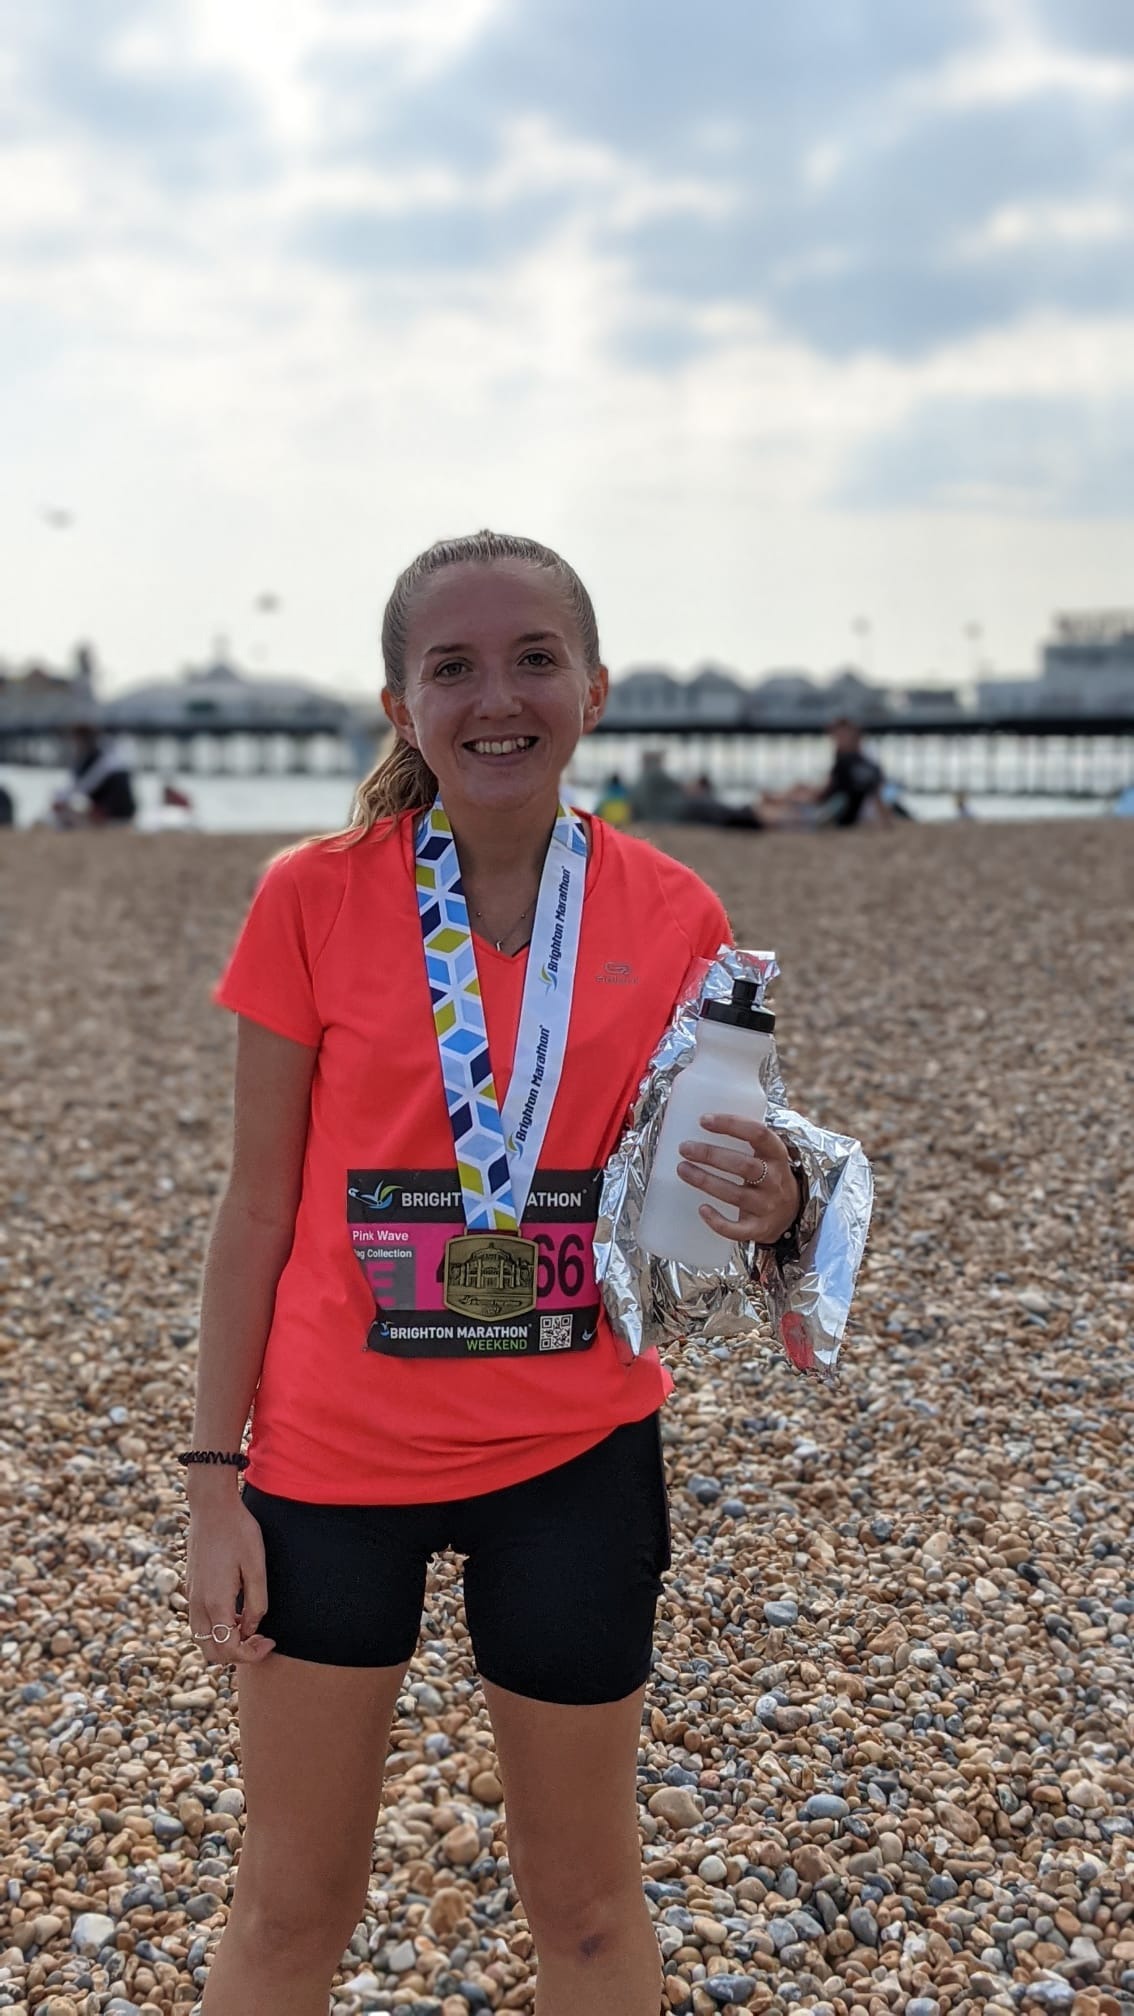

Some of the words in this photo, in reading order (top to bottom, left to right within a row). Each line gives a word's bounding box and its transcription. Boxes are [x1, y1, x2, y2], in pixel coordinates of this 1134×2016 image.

[555, 868, 571, 922] Marathon
[547, 922, 564, 973] Brighton
[515, 1088, 539, 1142] Brighton
[531, 1027, 550, 1087] Marathon
[401, 1192, 462, 1207] BRIGHT
[527, 1192, 582, 1207] ATHON
[352, 1230, 374, 1241] Pink
[377, 1230, 409, 1241] Wave
[367, 1248, 412, 1258] Collection
[390, 1327, 454, 1339] BRIGHTON
[457, 1325, 528, 1339] MARATHON
[466, 1339, 528, 1350] WEEKEND
